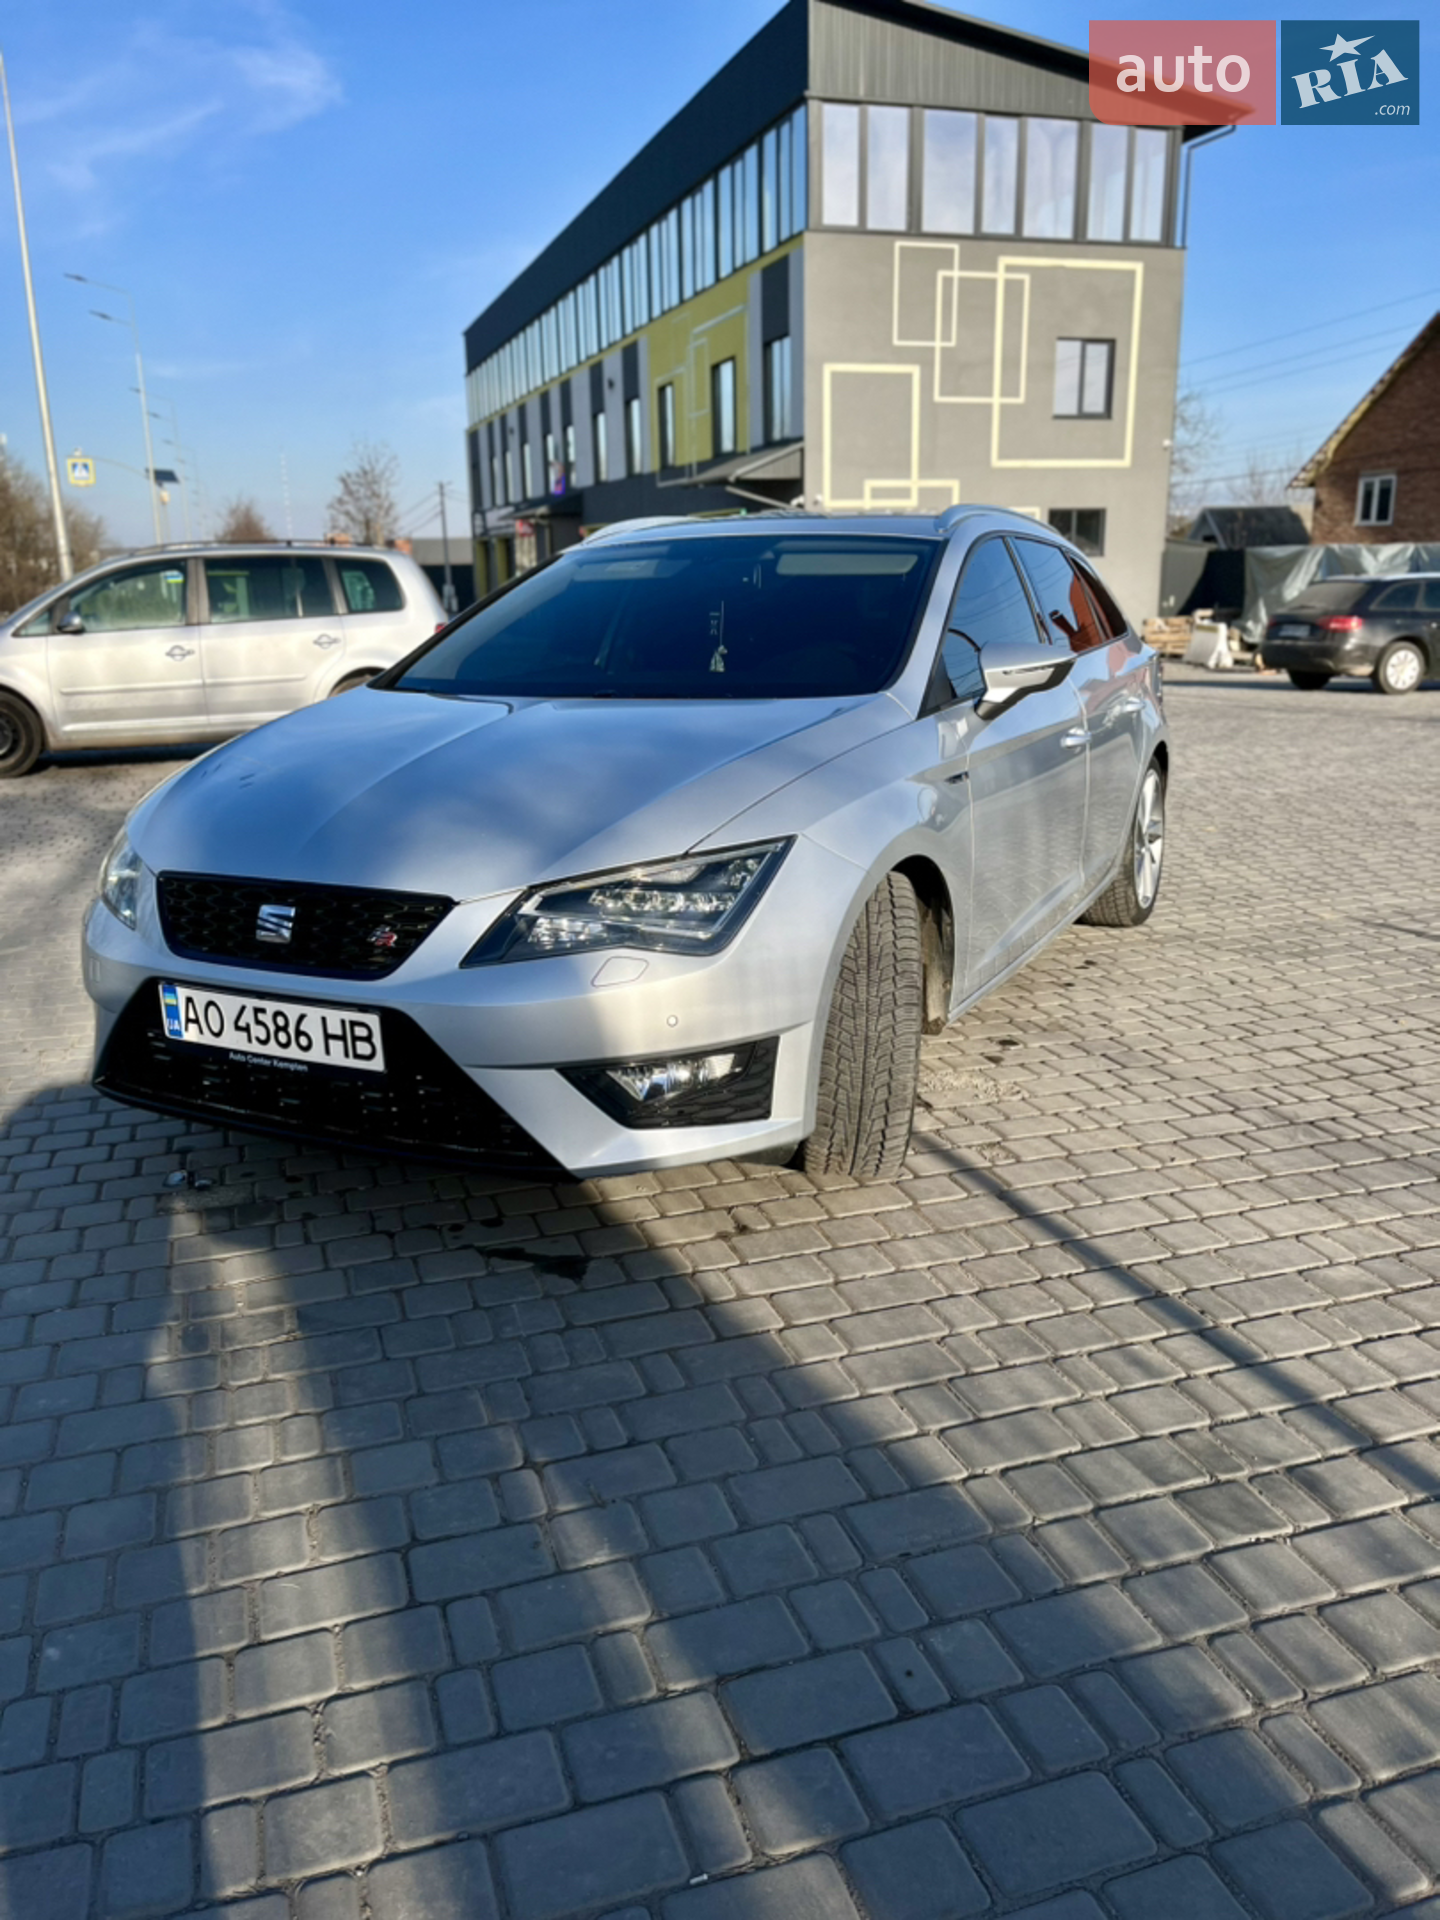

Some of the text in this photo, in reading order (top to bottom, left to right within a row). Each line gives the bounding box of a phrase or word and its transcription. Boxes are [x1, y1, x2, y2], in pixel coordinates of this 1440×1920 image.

[184, 996, 377, 1062] AO 4586 HB
